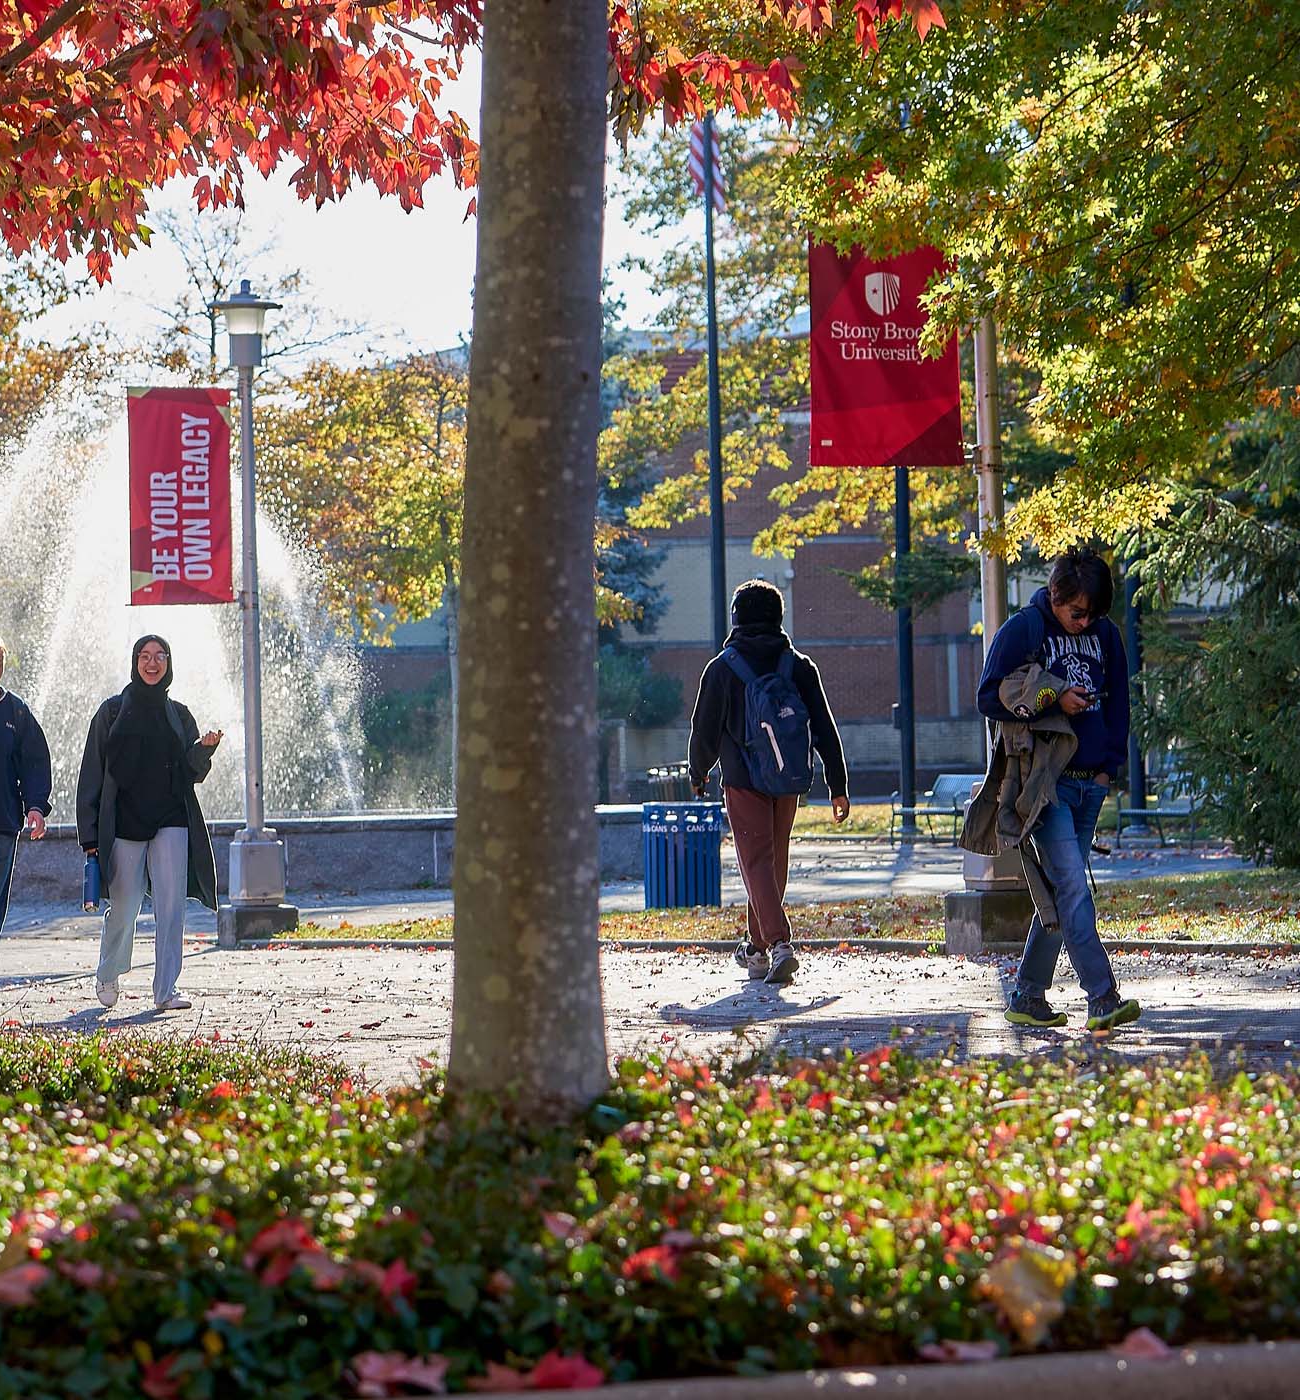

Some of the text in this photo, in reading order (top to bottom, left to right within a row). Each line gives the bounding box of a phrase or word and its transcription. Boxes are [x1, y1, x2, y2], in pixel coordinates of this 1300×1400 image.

[831, 321, 880, 342] Stony
[150, 471, 180, 581] BE YOUR
[181, 413, 212, 581] OWN LEGACY
